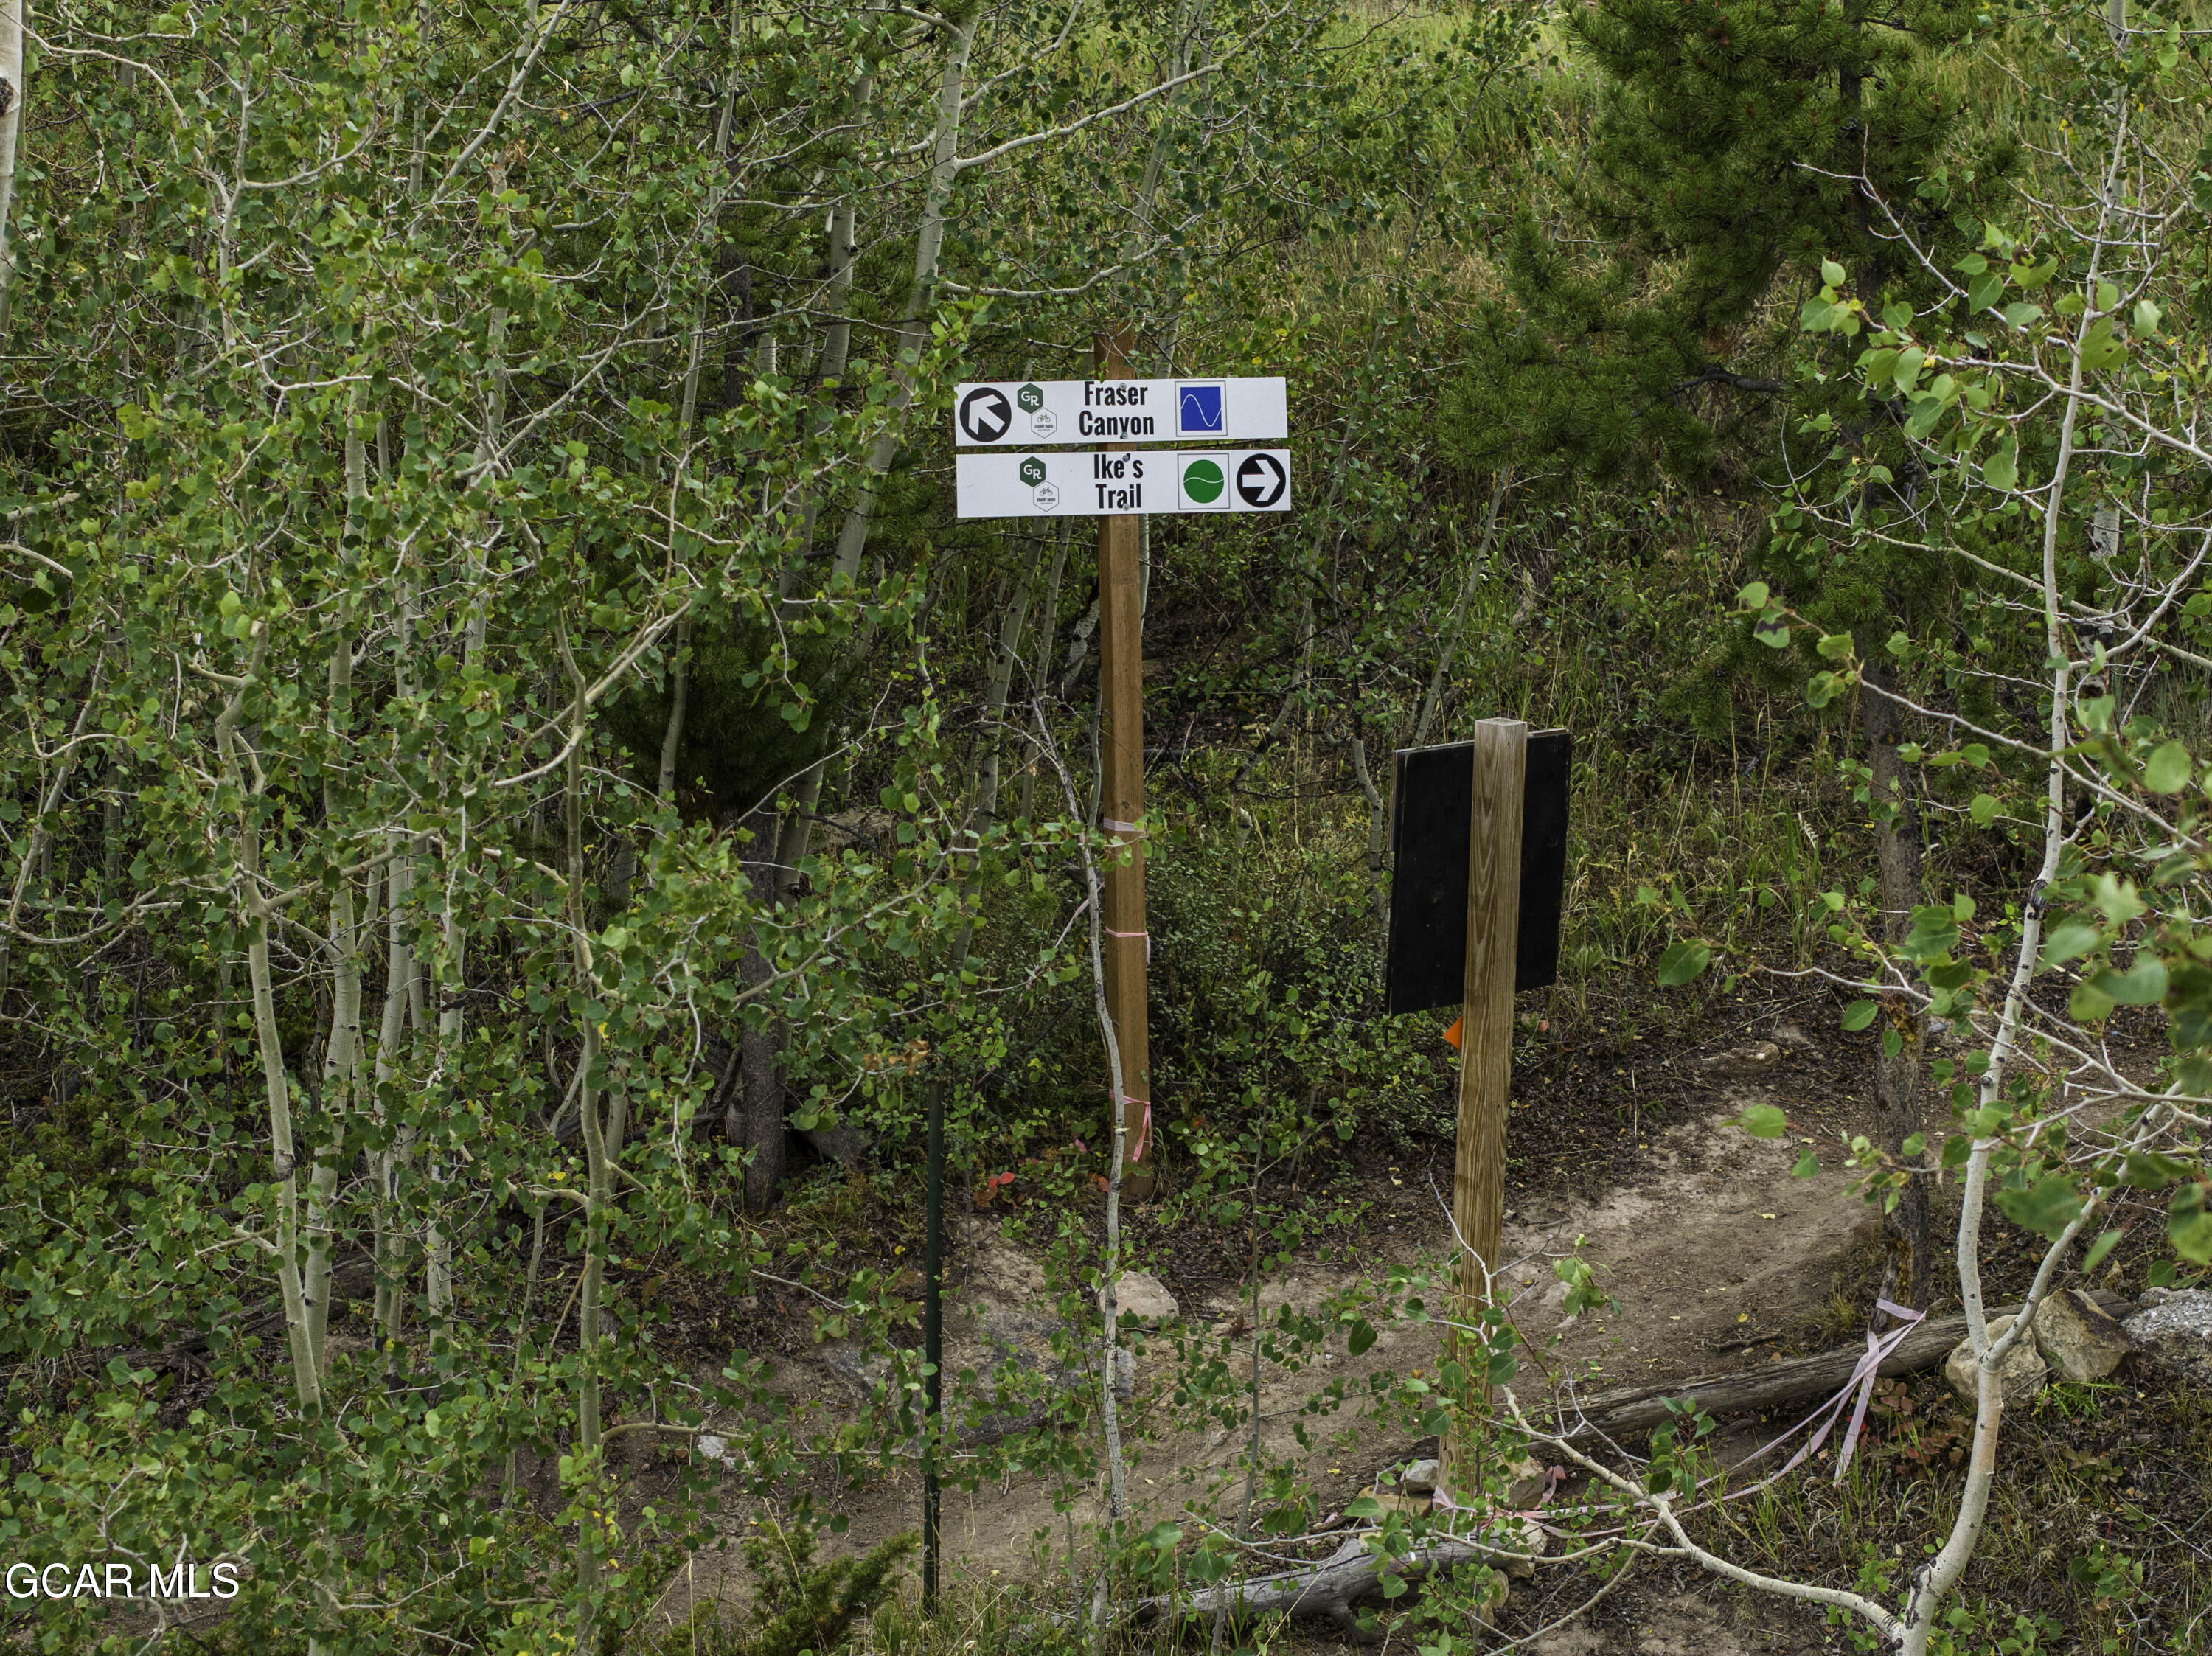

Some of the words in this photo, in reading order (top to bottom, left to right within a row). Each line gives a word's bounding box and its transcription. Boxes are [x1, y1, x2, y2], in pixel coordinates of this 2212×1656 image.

[1020, 391, 1040, 406] GR
[1084, 380, 1148, 406] Fraser
[1079, 410, 1155, 439] Canyon
[1023, 464, 1042, 480] GR
[1093, 453, 1144, 479] Ike's
[1095, 484, 1142, 509] Trail
